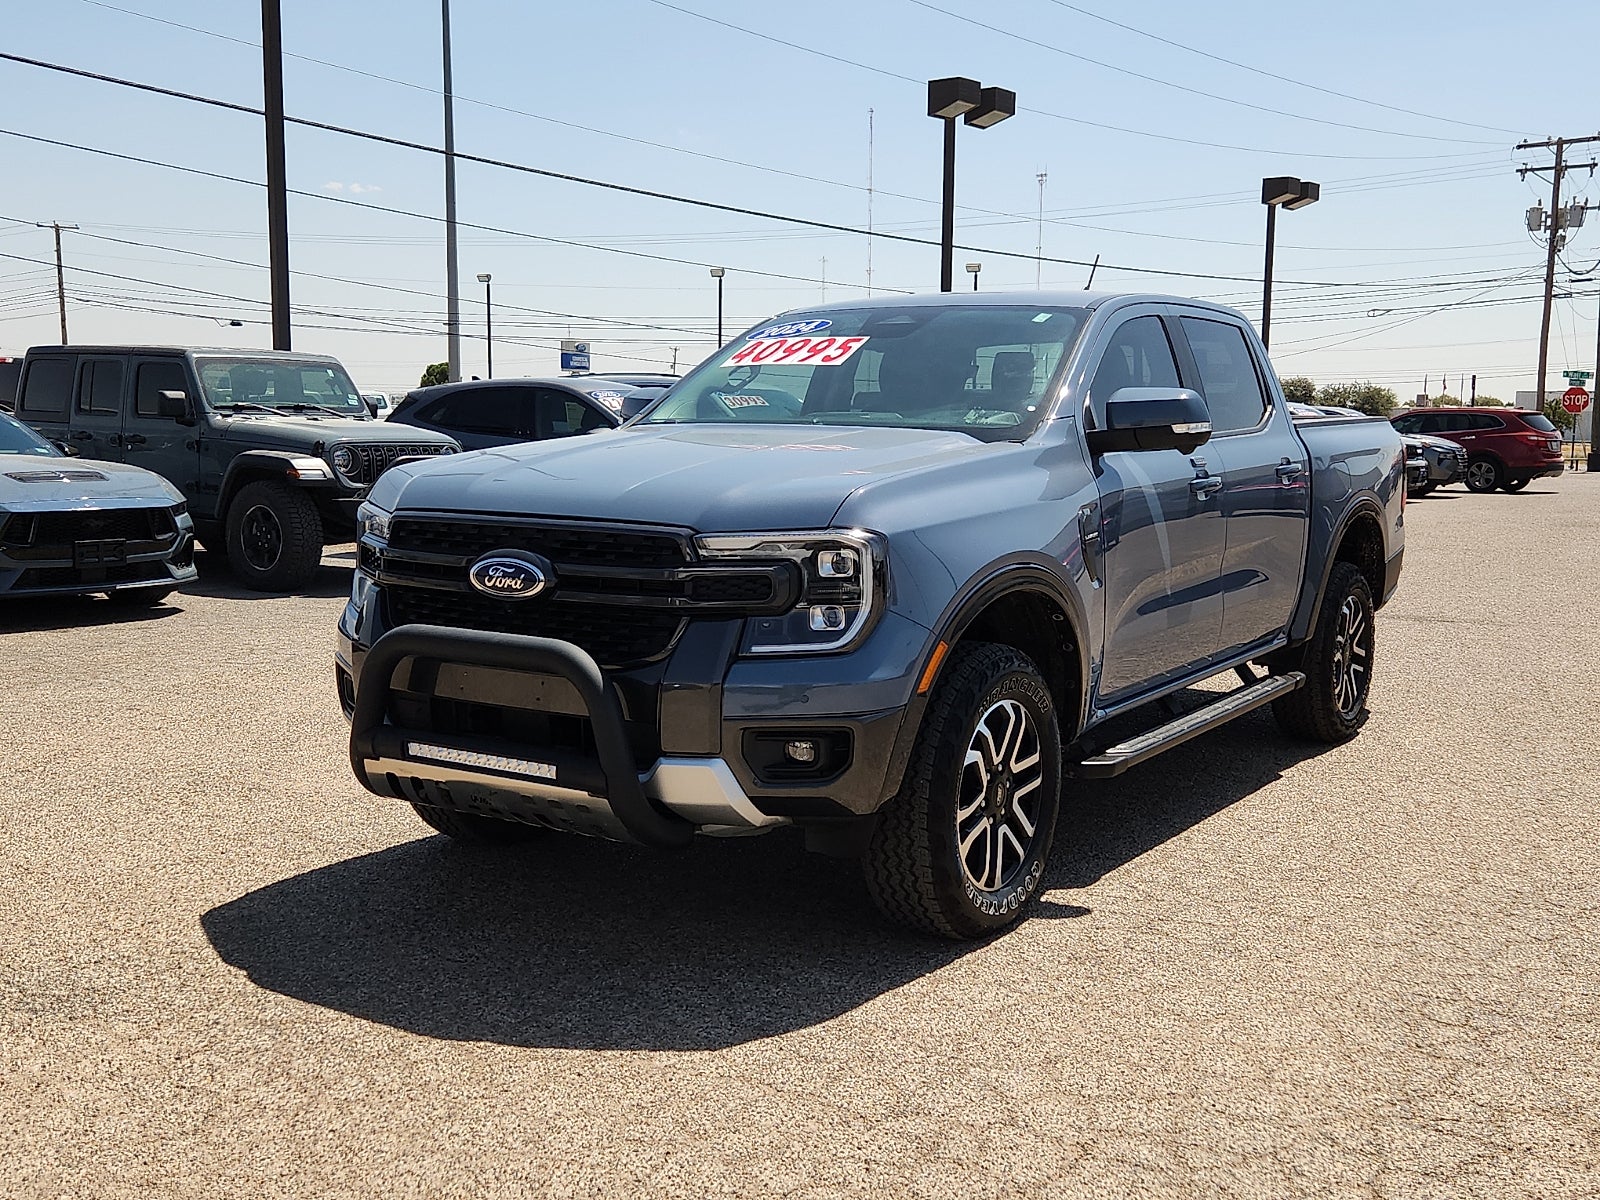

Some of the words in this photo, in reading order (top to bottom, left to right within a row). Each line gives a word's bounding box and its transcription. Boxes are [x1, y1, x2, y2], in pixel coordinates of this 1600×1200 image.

[754, 321, 822, 339] 2024
[731, 337, 865, 364] 40995
[724, 396, 766, 407] 30995
[1564, 394, 1588, 405] STOP
[485, 565, 525, 590] Ford
[965, 861, 1040, 915] GOODYEAR
